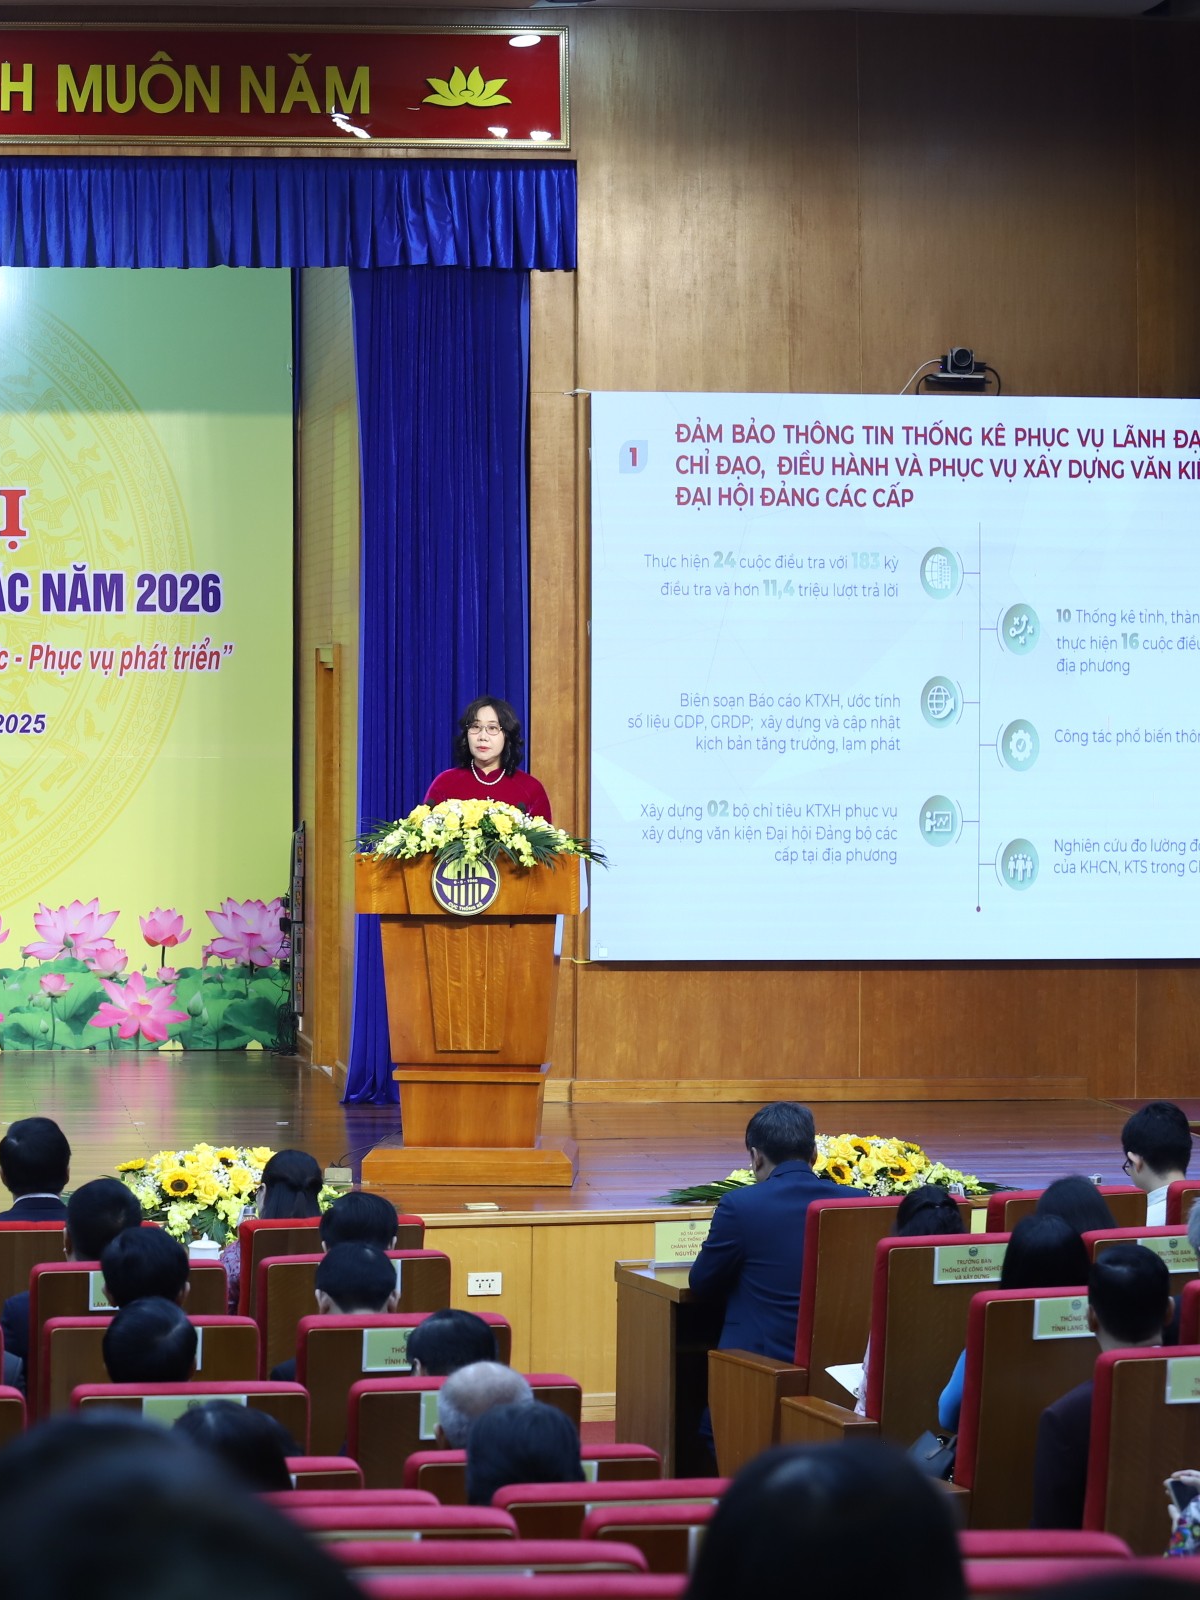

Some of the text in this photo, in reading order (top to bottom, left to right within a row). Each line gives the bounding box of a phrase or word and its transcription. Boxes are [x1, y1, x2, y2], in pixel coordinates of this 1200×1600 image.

[57, 52, 219, 113] MUÔN
[241, 53, 370, 114] NĂM
[675, 417, 722, 442] ĐẢM
[733, 417, 775, 443] BẢO
[783, 421, 854, 444] THÔNG
[862, 426, 893, 445] TIN
[902, 420, 972, 445] THỐNG
[982, 423, 1005, 446] KÊ
[1015, 428, 1069, 451] PHỤC
[1077, 428, 1103, 452] VỤ
[1114, 425, 1165, 448] LÃNH
[629, 447, 638, 467] 1
[676, 448, 709, 474] CHỈ
[716, 456, 765, 479] ĐẠO,
[777, 450, 824, 475] ĐIỀU
[832, 453, 888, 476] HÀNH
[895, 453, 923, 476] VÀ
[930, 458, 983, 482] PHỤC
[990, 458, 1016, 482] VỤ
[1024, 455, 1062, 478] XÂY
[1069, 457, 1124, 484] DỰNG
[1131, 455, 1171, 479] VĂN
[675, 481, 913, 512] ĐẠI HỘI ĐẢNG CÁC CẤP
[644, 550, 899, 572] Thực hiện 24 cuộc điều tra với 183 kỳ
[43, 565, 123, 611] NĂM
[137, 574, 221, 612] 2026
[661, 579, 898, 600] điều tra và hơn 11,4 triệu lượt trả lời
[1057, 608, 1071, 622] 10
[1076, 607, 1116, 626] Thống
[1121, 609, 1135, 623] kê
[1139, 608, 1167, 625] tỉnh,
[1057, 635, 1085, 651] thực
[1091, 635, 1117, 651] hiện
[1122, 632, 1139, 649] 16
[1143, 635, 1173, 652] cuộc
[29, 644, 82, 676] Phục
[90, 651, 114, 676] vụ
[120, 644, 168, 676] phát
[174, 638, 233, 670] triển”
[1057, 657, 1129, 675] địa phương
[1055, 728, 1088, 746] Công
[1093, 729, 1112, 743] tác
[1117, 727, 1140, 746] phổ
[1145, 728, 1171, 742] biến
[641, 799, 897, 821] Xây dựng 02 bộ chỉ tiêu KTXH phục vụ
